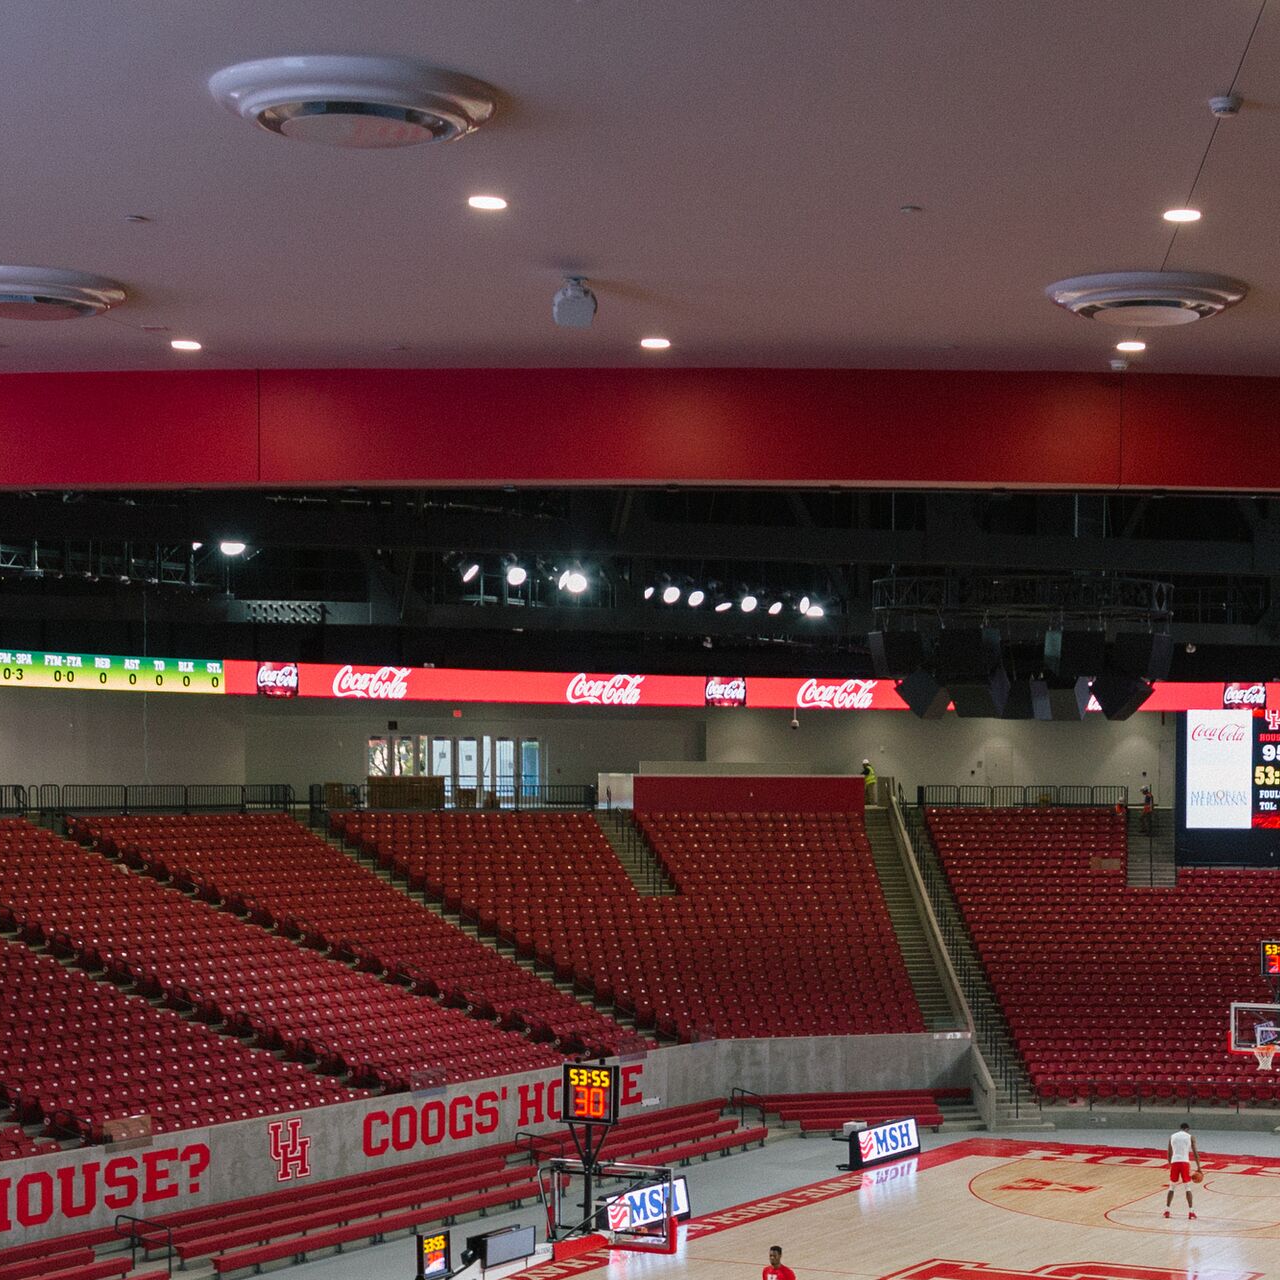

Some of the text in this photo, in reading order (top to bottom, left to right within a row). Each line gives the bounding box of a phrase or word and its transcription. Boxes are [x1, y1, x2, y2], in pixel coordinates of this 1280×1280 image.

[99, 672, 107, 684] 0
[129, 673, 137, 685] 0
[155, 674, 163, 686] 0
[182, 675, 191, 687] 0
[211, 676, 219, 688] 0
[124, 658, 140, 670] AST
[153, 660, 165, 671] TO
[178, 661, 194, 672] BLK
[206, 662, 222, 673] STL
[257, 666, 298, 687] Coca-Cola
[332, 665, 412, 700] Coca-Cola
[566, 673, 645, 705] Coca-Cola
[706, 680, 745, 700] Coca-Cola
[797, 678, 878, 709] Coca-Cola
[1259, 802, 1277, 811] TOL:
[569, 1068, 610, 1087] 53:55
[575, 1086, 605, 1118] 30
[362, 1086, 508, 1157] COOGS'
[268, 1117, 312, 1183] UH
[875, 1121, 914, 1159] MSH
[628, 1183, 680, 1225] MSH
